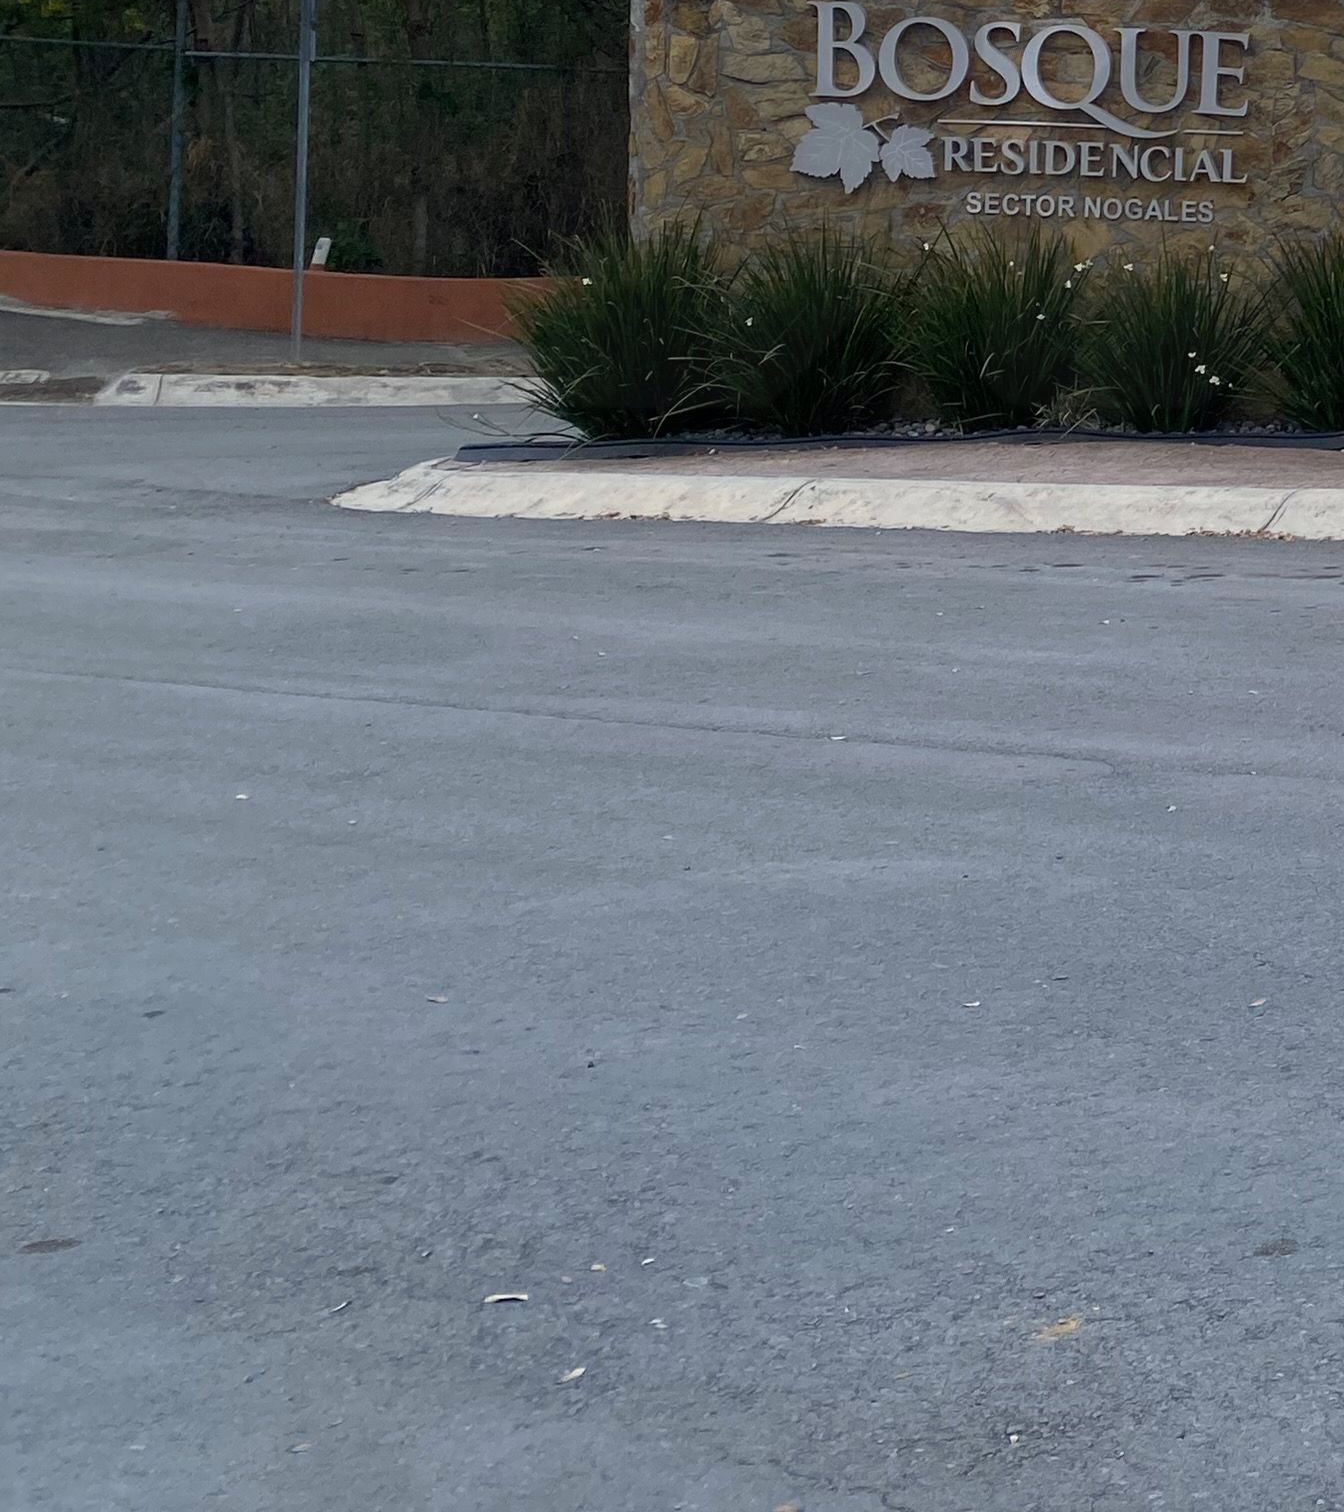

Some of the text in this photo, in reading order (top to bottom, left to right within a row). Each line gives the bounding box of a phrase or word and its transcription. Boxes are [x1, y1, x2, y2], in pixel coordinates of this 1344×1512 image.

[807, 1, 1250, 139] BOSQUE
[940, 136, 1248, 184] RESIDENCIAL
[966, 191, 1214, 224] SECTOR NOGALES
